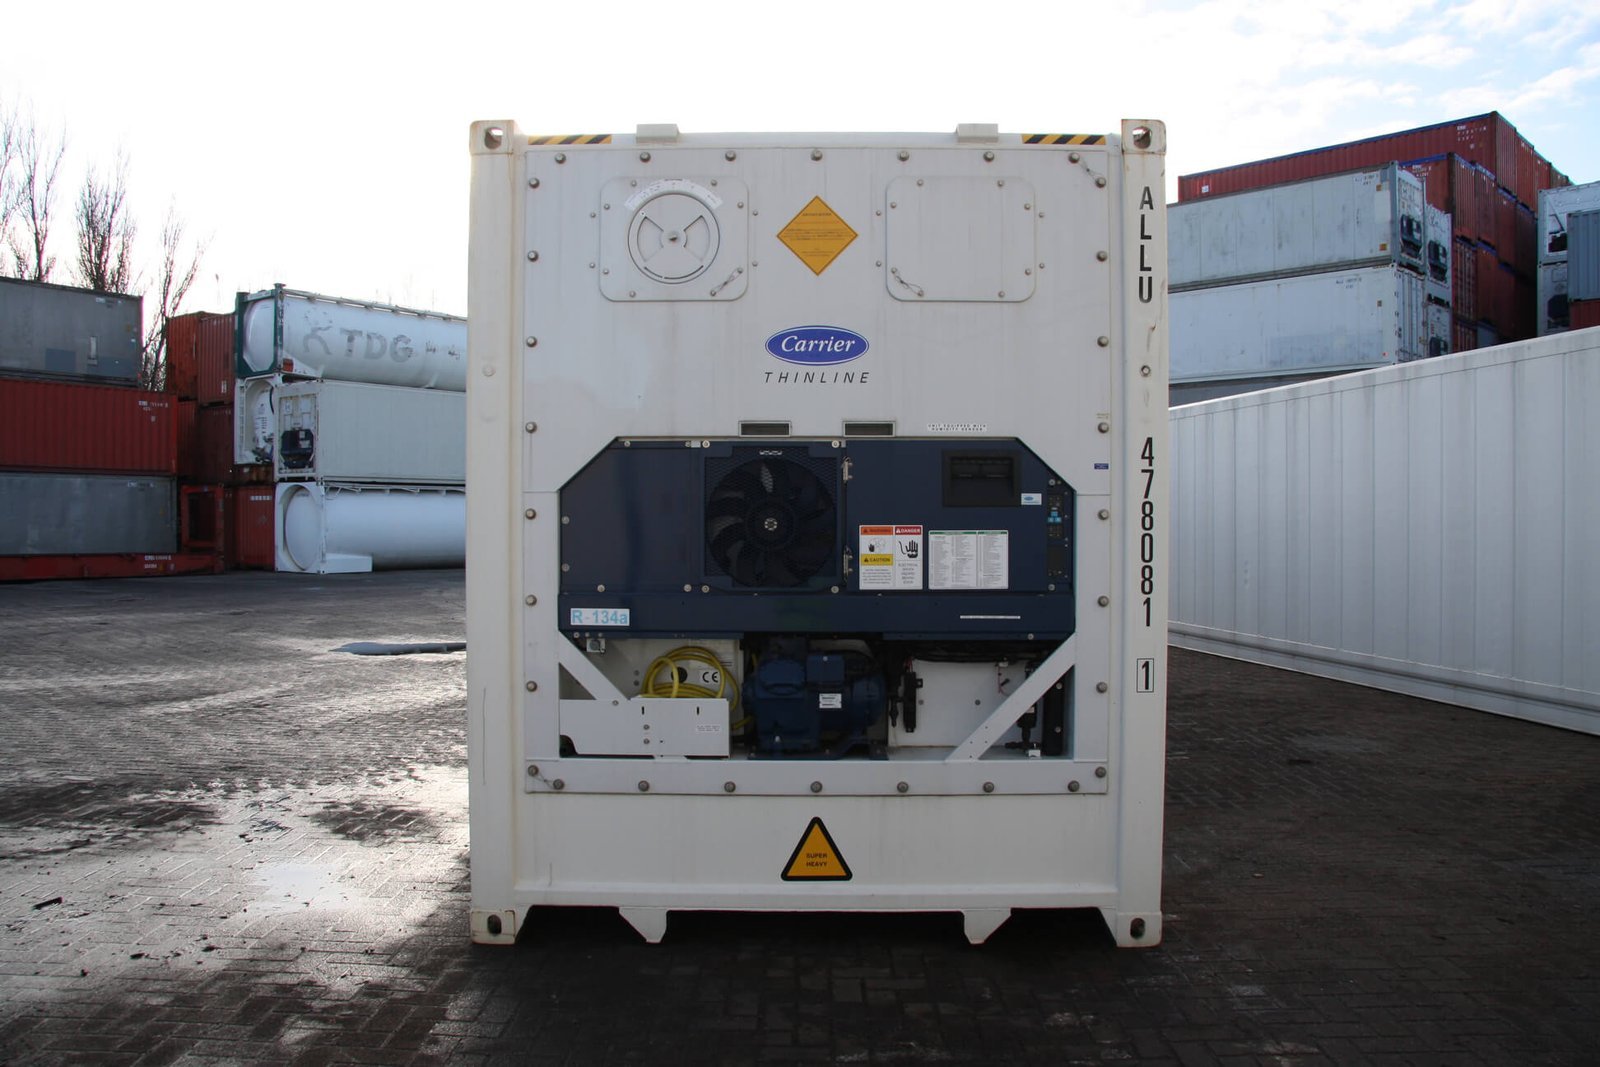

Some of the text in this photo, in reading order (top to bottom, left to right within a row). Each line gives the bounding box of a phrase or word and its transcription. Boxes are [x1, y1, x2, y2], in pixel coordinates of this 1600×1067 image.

[1139, 186, 1154, 304] ALLU
[340, 327, 414, 362] TDG
[781, 335, 855, 353] Carrier
[764, 372, 870, 384] THINLINE
[1141, 436, 1155, 627] 478081
[571, 609, 628, 624] R-134a
[702, 671, 719, 683] CE
